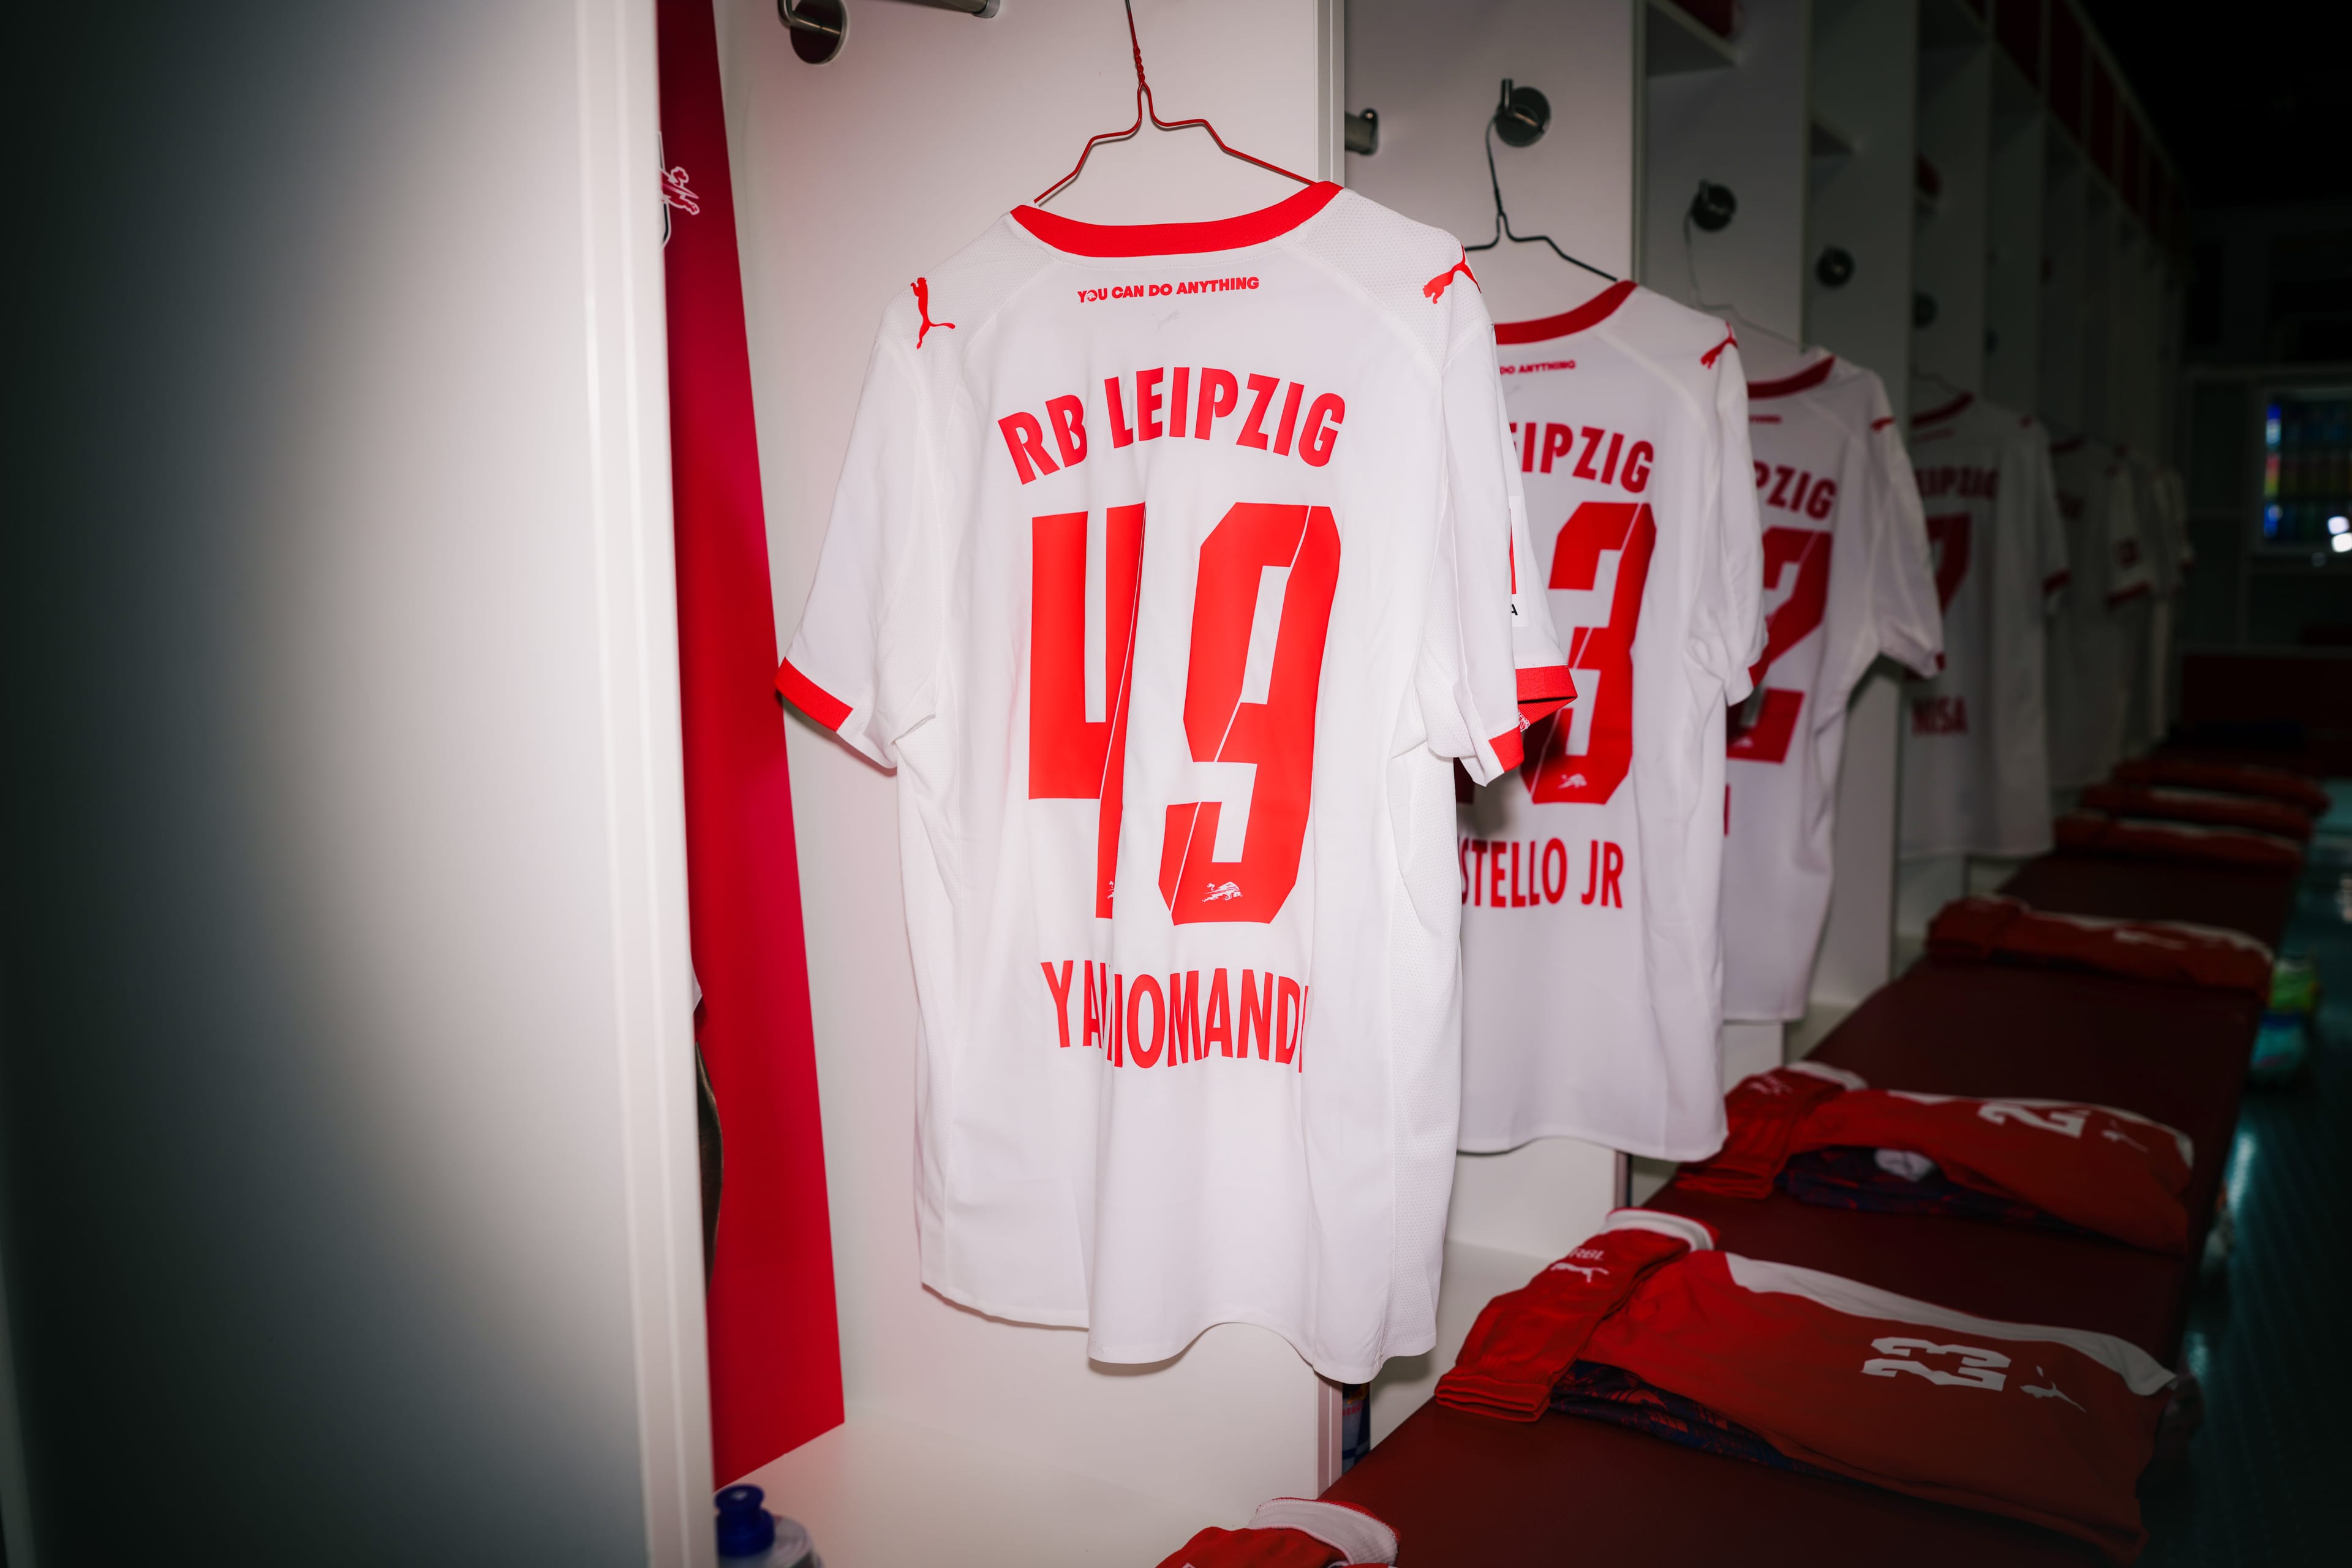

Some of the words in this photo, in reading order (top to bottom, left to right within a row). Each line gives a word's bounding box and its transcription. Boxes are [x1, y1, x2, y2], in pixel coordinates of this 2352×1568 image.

[1077, 287, 1107, 303] YOU
[1112, 285, 1144, 300] CAN
[1148, 283, 1172, 297] DO
[1176, 276, 1259, 295] ANYTHING
[998, 394, 1088, 485] RB
[1104, 367, 1346, 467] LEIPZIG
[1509, 421, 1654, 495] IPZIG
[1454, 501, 1657, 806] 3
[1028, 500, 1341, 927] 49
[1581, 839, 1624, 910] JR
